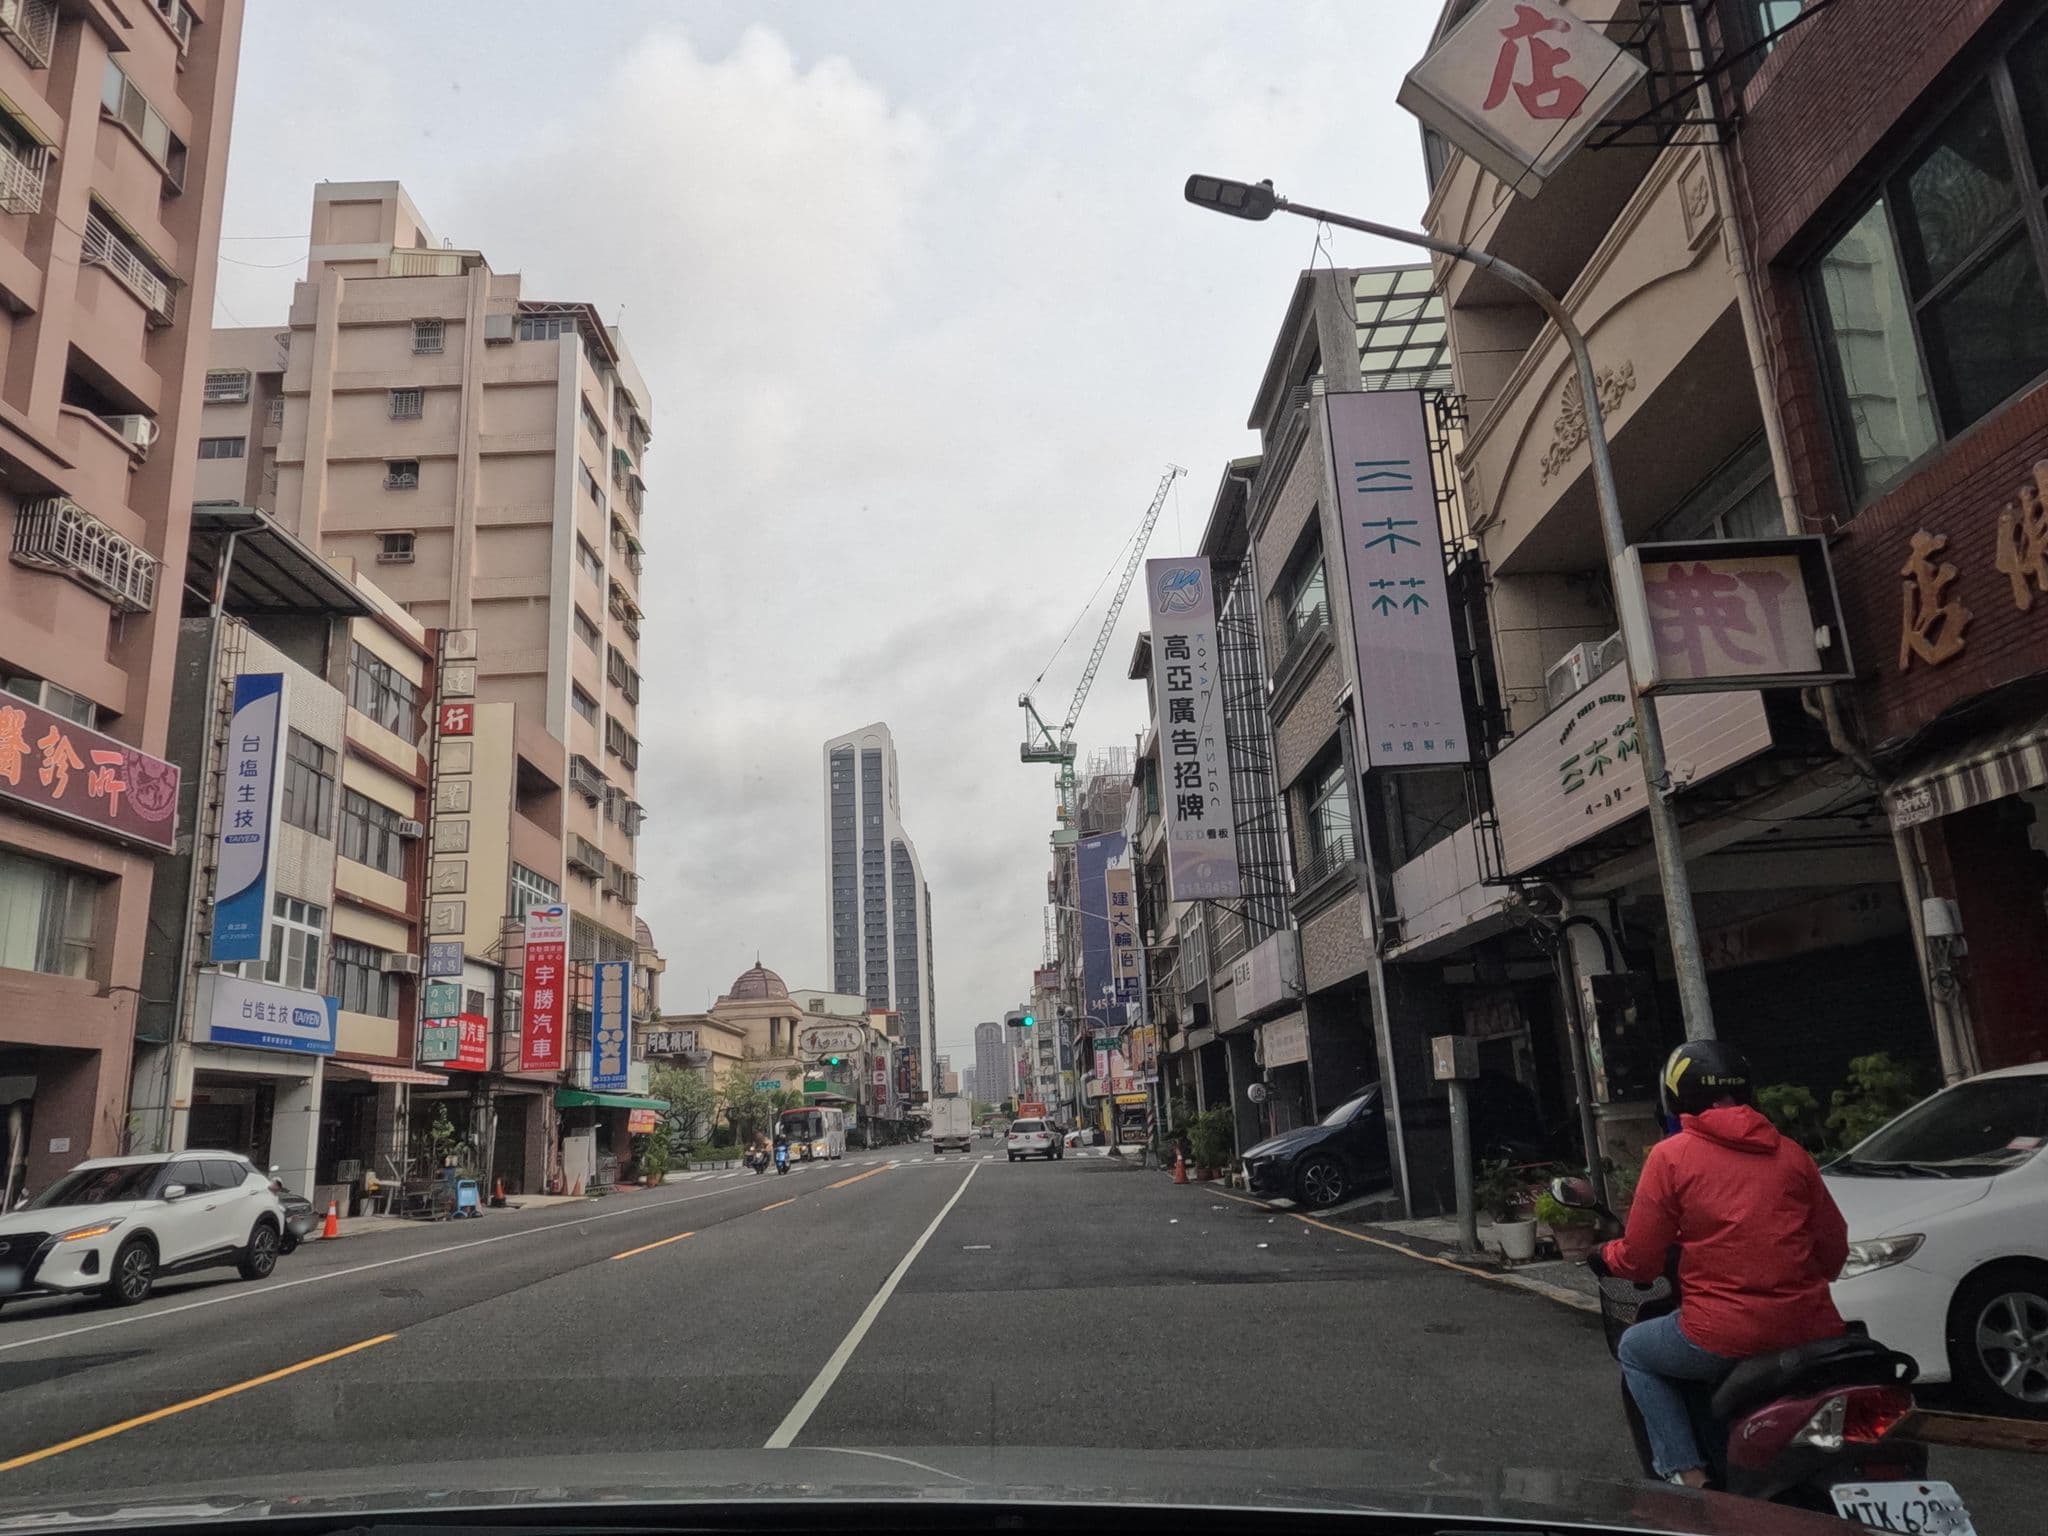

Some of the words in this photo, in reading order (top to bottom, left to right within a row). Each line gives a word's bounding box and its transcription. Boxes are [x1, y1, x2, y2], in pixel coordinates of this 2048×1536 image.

[1482, 4, 1587, 119] 店
[1355, 460, 1429, 616] 三木林
[1163, 634, 1204, 821] 高亞廣告招牌
[234, 735, 260, 828] 台塩生技
[228, 835, 258, 843] TAIYEN
[242, 998, 288, 1024] 台塩生技
[295, 1010, 320, 1025] TAIYEN
[531, 964, 555, 1059] 宇勝汽車
